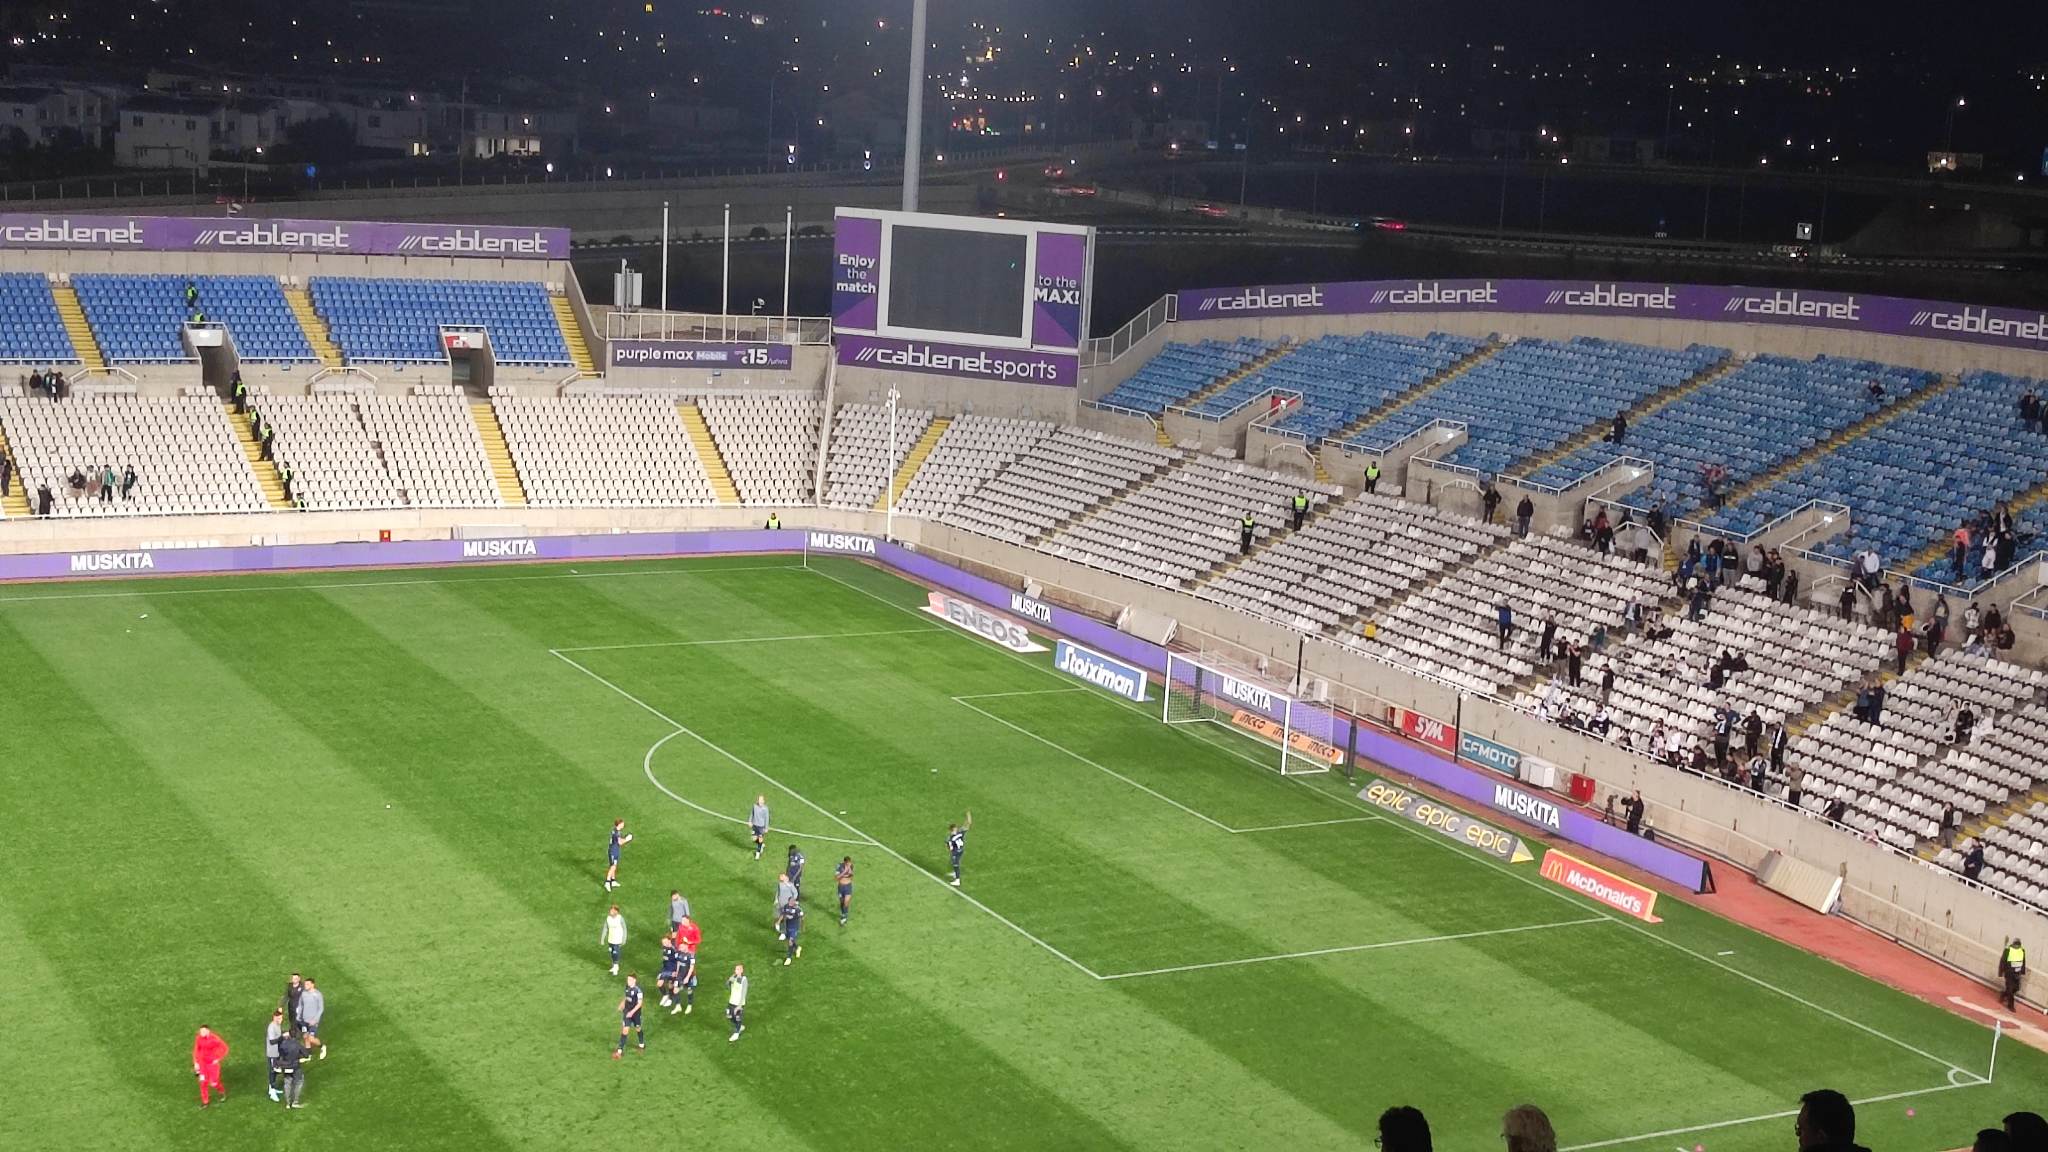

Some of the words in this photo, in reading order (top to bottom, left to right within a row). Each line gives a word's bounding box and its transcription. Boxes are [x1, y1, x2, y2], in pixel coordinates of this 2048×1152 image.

[5, 220, 143, 244] cablenet
[218, 223, 349, 248] cablenet
[421, 230, 548, 253] cablenet
[839, 254, 875, 268] Enjoy
[847, 268, 867, 280] the
[1039, 275, 1051, 286] to
[1056, 275, 1077, 288] the
[836, 281, 876, 294] match
[1034, 287, 1080, 305] MAX!
[1217, 286, 1323, 310] cablenet
[1389, 282, 1498, 304] cablenet
[1565, 283, 1676, 309] cablenet
[1744, 291, 1860, 320] cablenet
[1931, 307, 2048, 340] cablenet
[616, 348, 661, 362] purple
[663, 350, 694, 361] max
[463, 539, 537, 557] MUSKITA
[810, 532, 875, 554] MUSKITA
[71, 552, 154, 571] MUSKITA
[1011, 593, 1051, 623] MUSKITA
[949, 600, 1022, 648] ENEOS
[1060, 646, 1135, 697] Stoiximan
[1222, 677, 1272, 712] MUSKITA
[1415, 716, 1444, 741] SYM
[1461, 739, 1518, 768] CFMOTO
[1367, 783, 1412, 812] epic
[1415, 804, 1460, 832] epic
[1466, 825, 1511, 854] epic
[1494, 785, 1561, 829] MUSKITA
[1566, 870, 1642, 913] McDonald's
